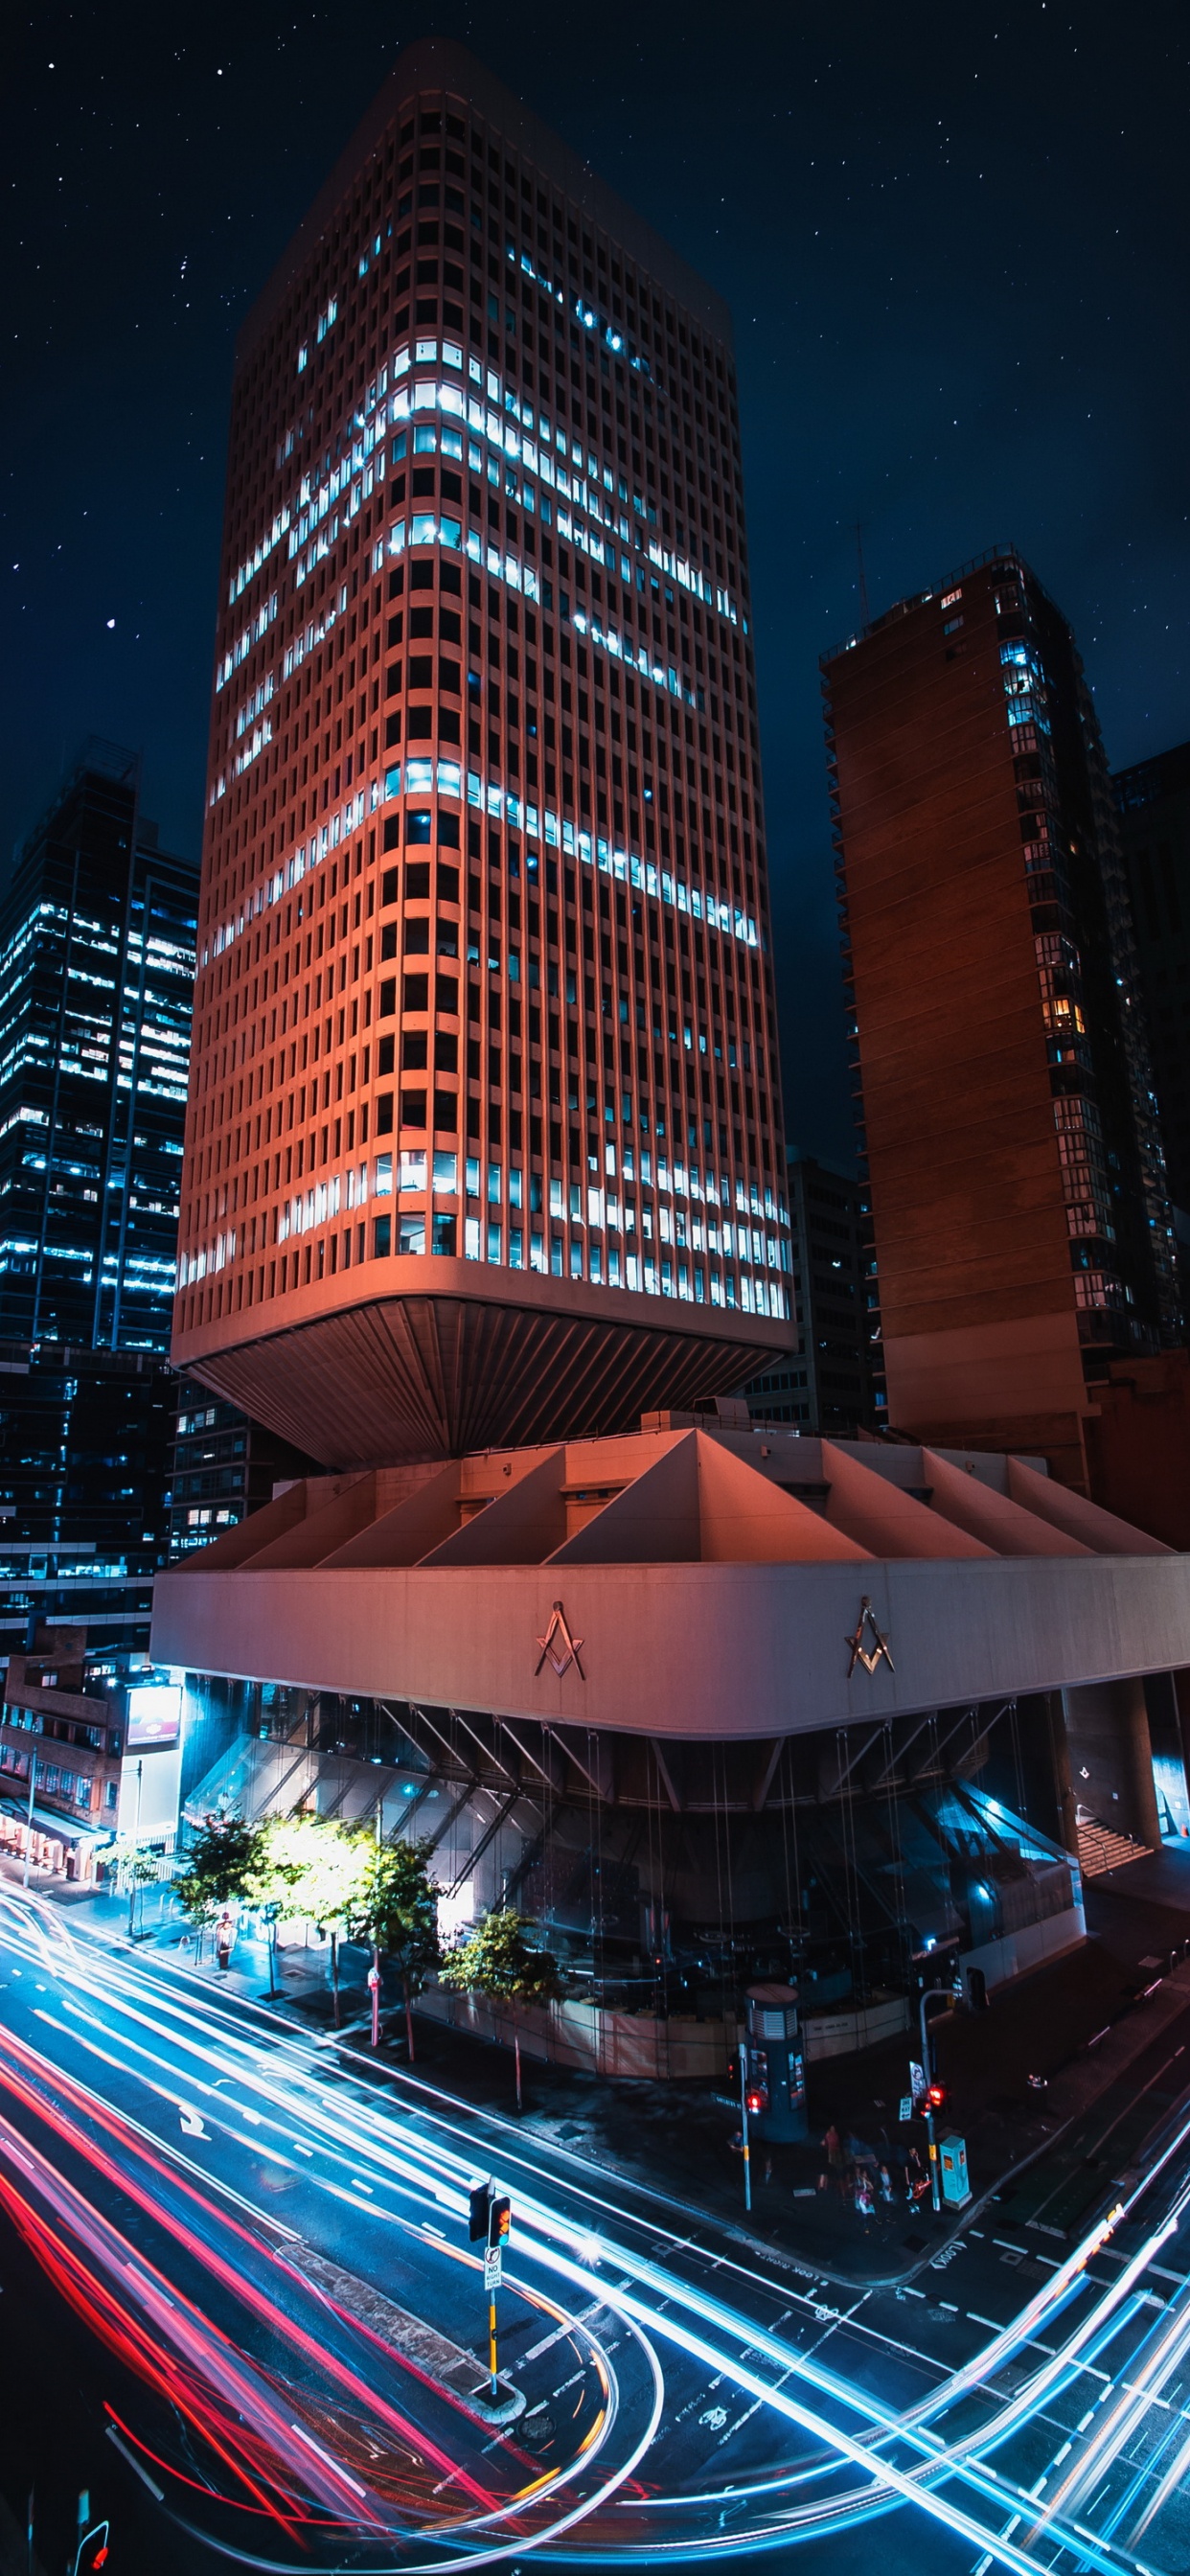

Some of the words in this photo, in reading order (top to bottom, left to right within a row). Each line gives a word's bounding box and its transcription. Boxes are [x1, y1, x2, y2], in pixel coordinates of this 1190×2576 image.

[935, 2245, 963, 2266] LOOK
[488, 2265, 498, 2273] NO
[486, 2272, 500, 2281] RIGHT
